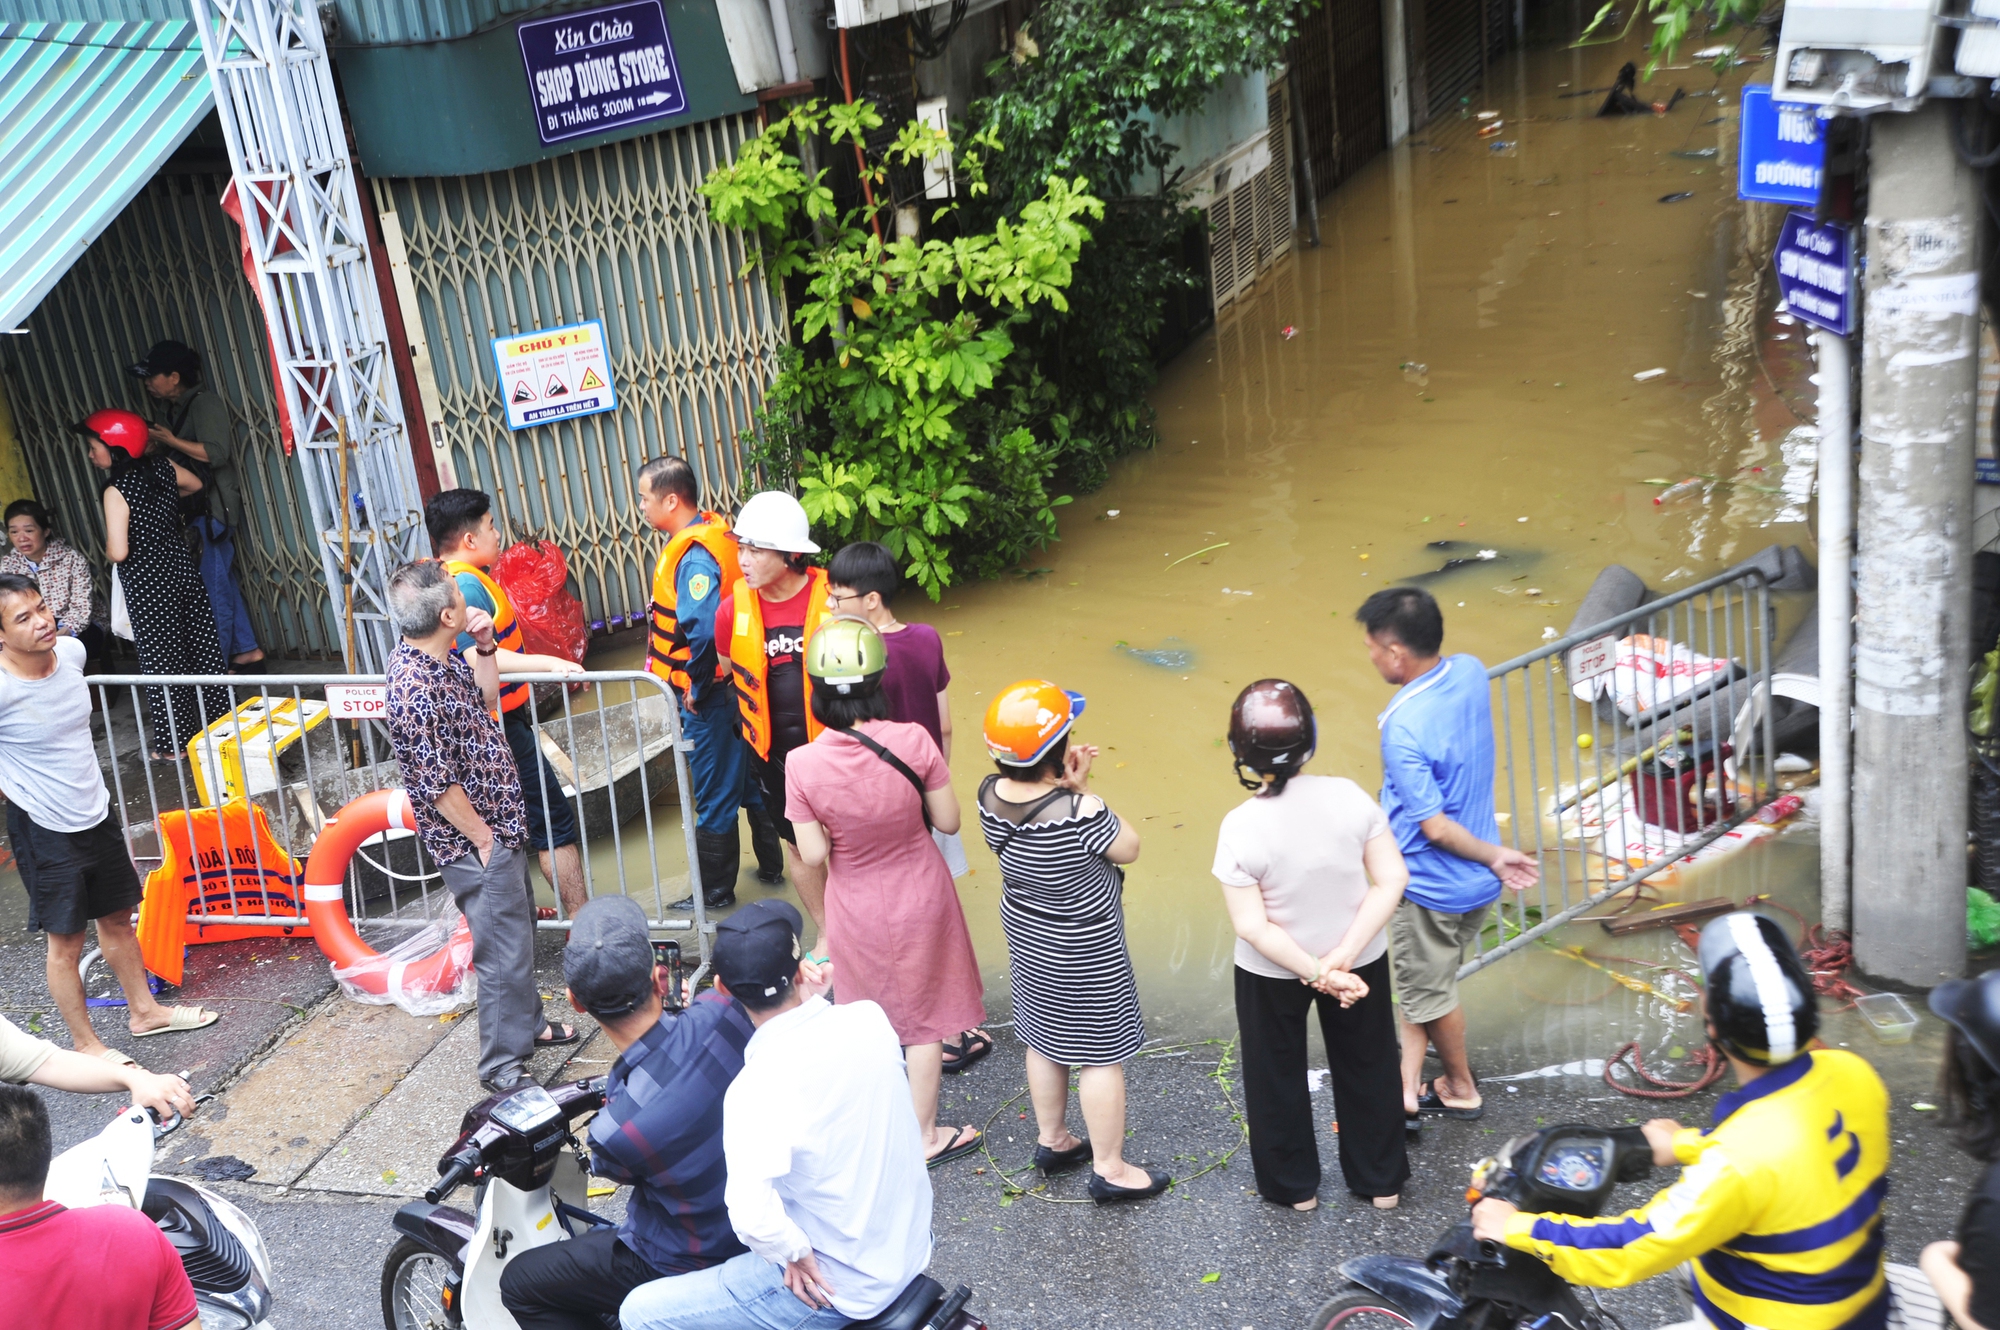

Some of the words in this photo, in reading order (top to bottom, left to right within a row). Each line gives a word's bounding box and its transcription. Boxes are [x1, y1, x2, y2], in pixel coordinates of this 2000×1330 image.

[555, 26, 586, 51] Xin
[589, 18, 633, 45] Chào
[536, 65, 574, 108] SHOP
[618, 44, 671, 89] STORE
[547, 113, 559, 131] ĐI
[560, 102, 599, 127] THẲNG
[602, 96, 635, 118] 300M
[1755, 159, 1813, 189] ĐƯỜNG
[519, 337, 553, 353] CHÚ
[558, 334, 567, 346] Ý
[528, 411, 539, 421] AN
[539, 407, 556, 419] TOÀN
[557, 404, 566, 415] LÀ
[566, 402, 583, 413] TRÊN
[1580, 653, 1606, 673] STOP
[343, 701, 384, 712] STOP
